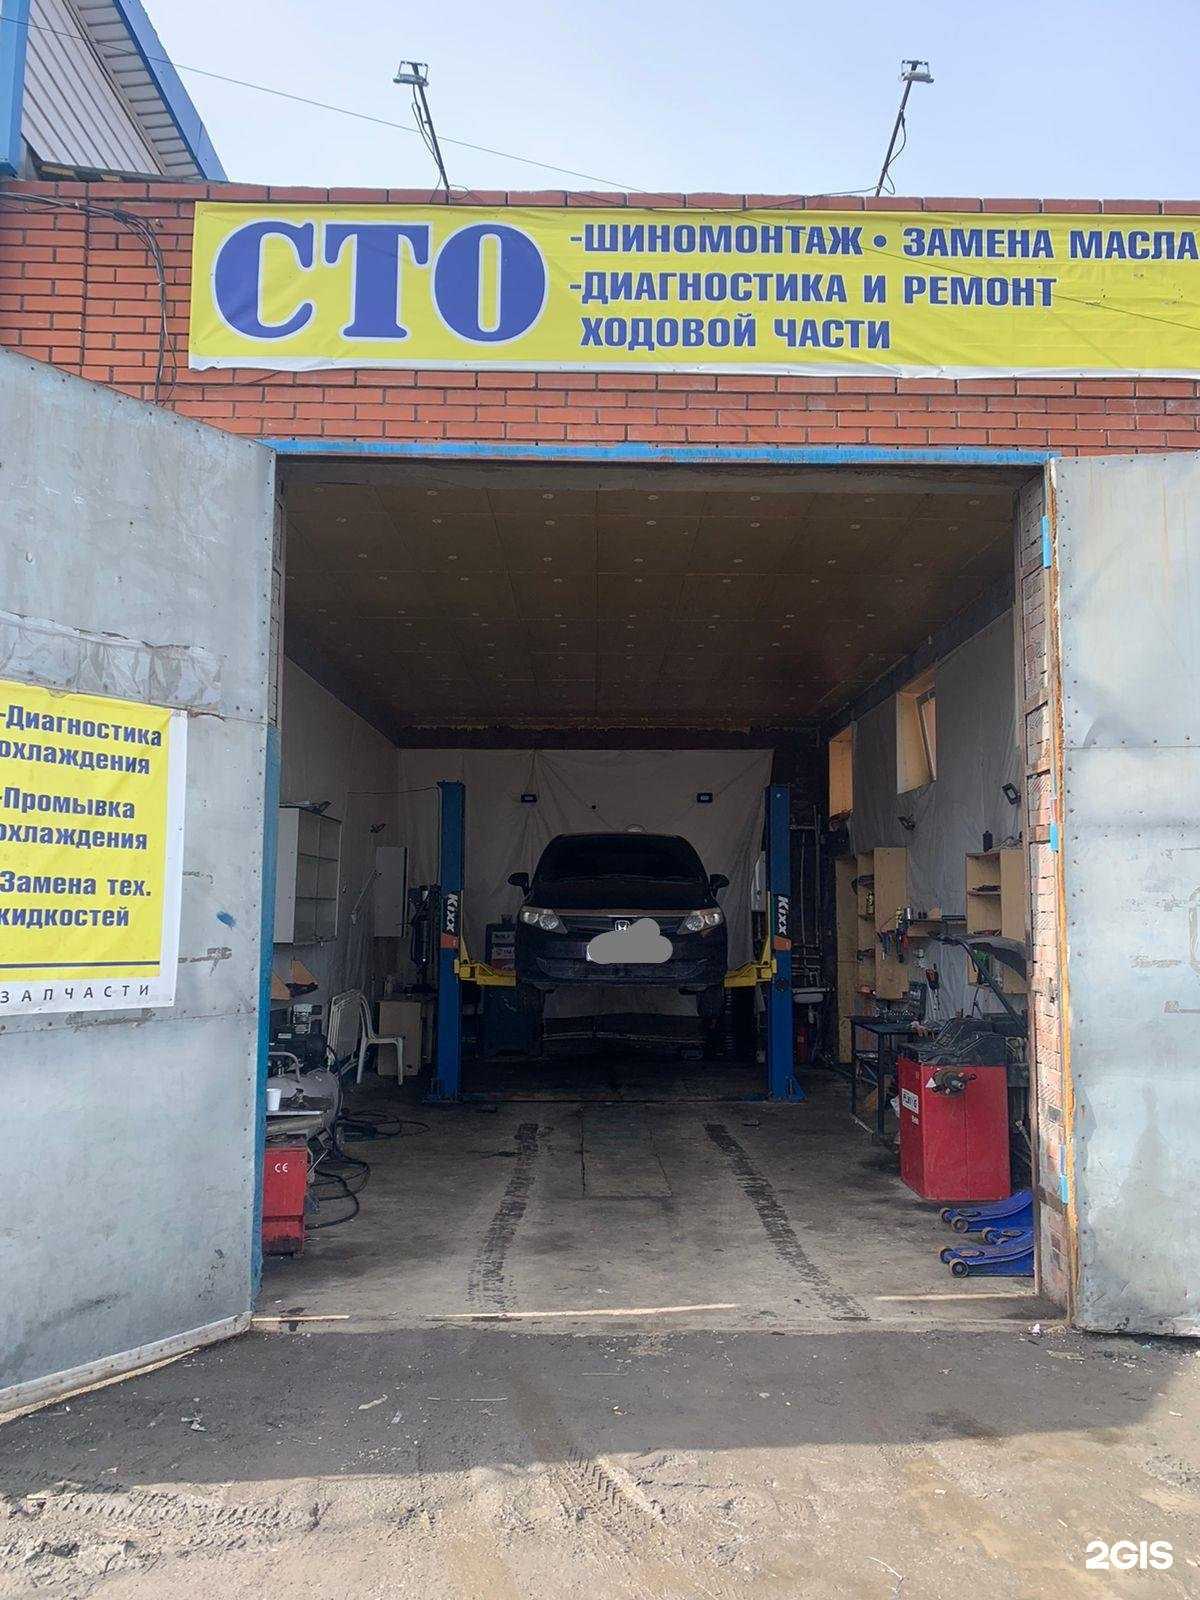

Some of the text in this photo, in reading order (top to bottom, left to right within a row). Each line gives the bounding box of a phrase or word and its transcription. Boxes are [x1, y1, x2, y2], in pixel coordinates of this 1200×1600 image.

[570, 224, 1200, 260] -ШИНОМОНТАЖ ЗАМЕНА МАСЛА
[214, 220, 548, 344] СТО
[570, 272, 1057, 307] -ДИАГНОСТИКА И РЕМОНТ
[581, 315, 891, 352] ХОДОВОЙ ЧАСТИ
[0, 870, 152, 898] Замена тех.
